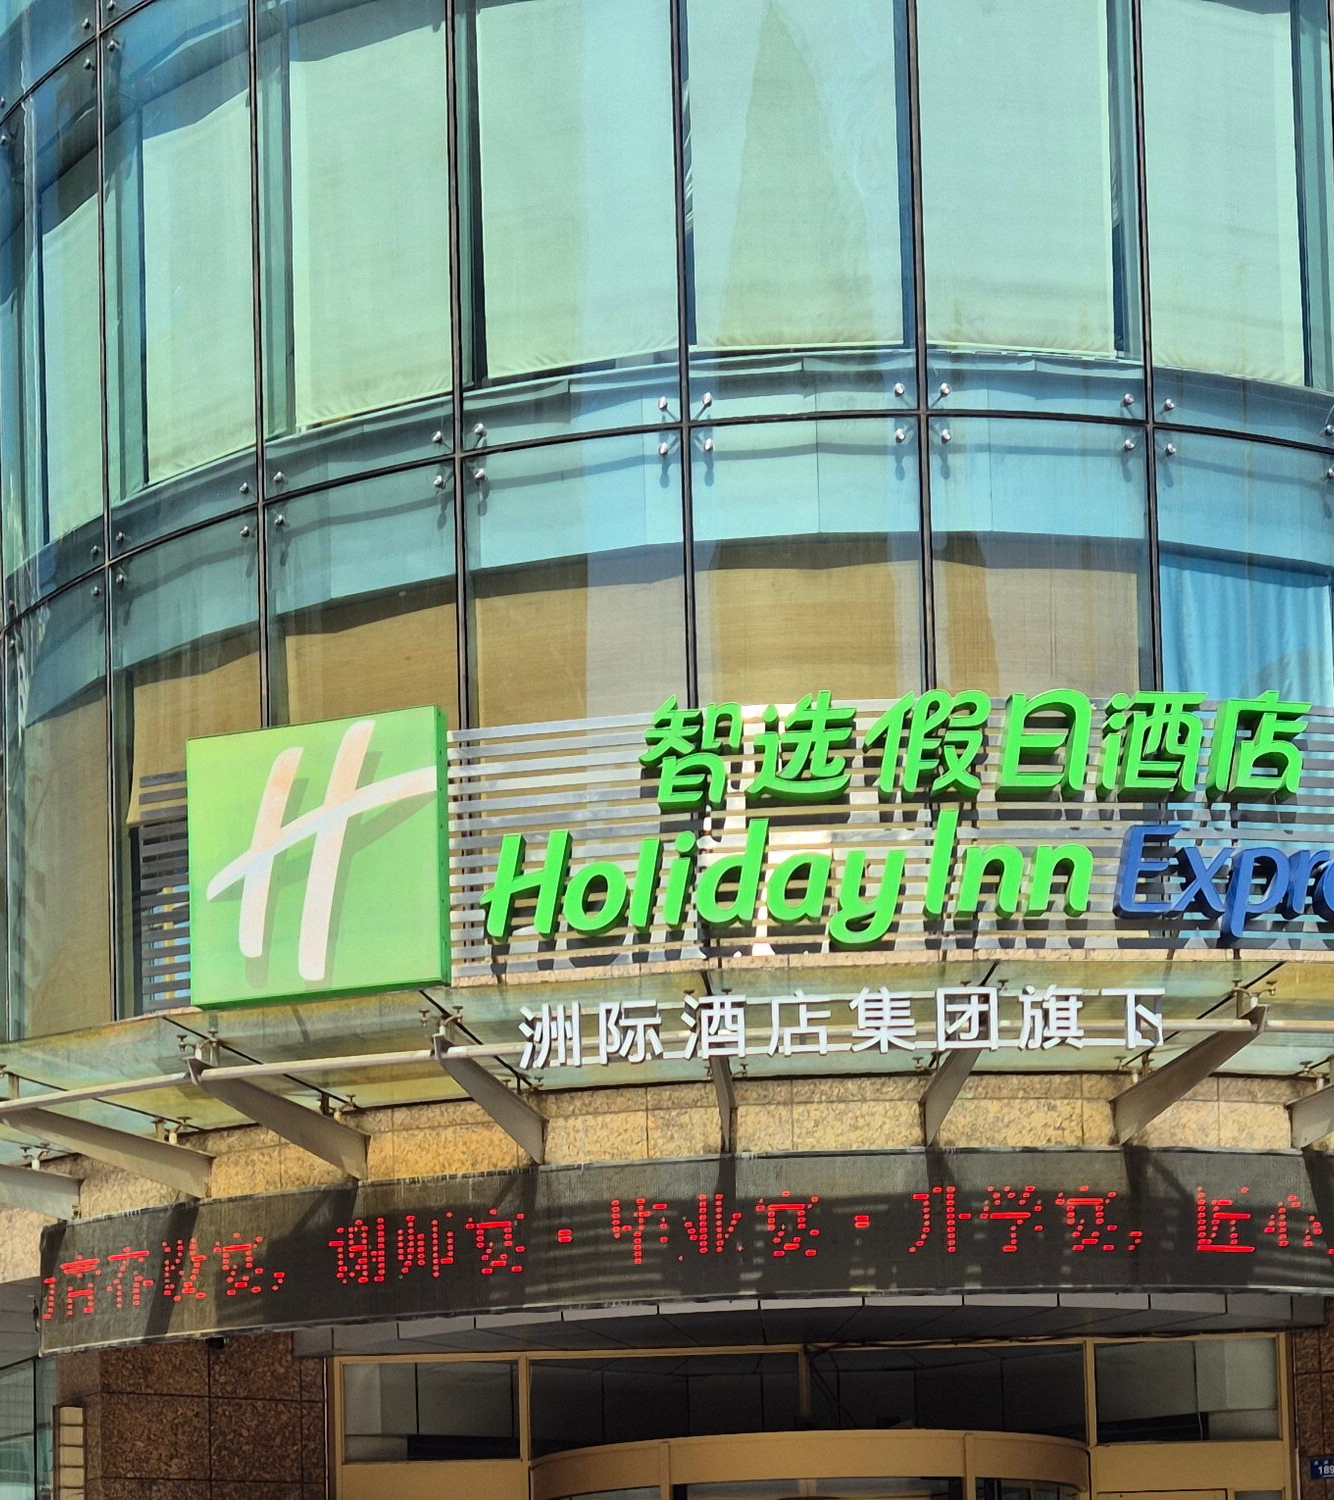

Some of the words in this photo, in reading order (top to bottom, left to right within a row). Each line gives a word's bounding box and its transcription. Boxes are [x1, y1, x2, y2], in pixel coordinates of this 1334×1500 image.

[638, 690, 1313, 812] 智选假日酒店
[519, 985, 1165, 1068] 洲际酒店集团旗下
